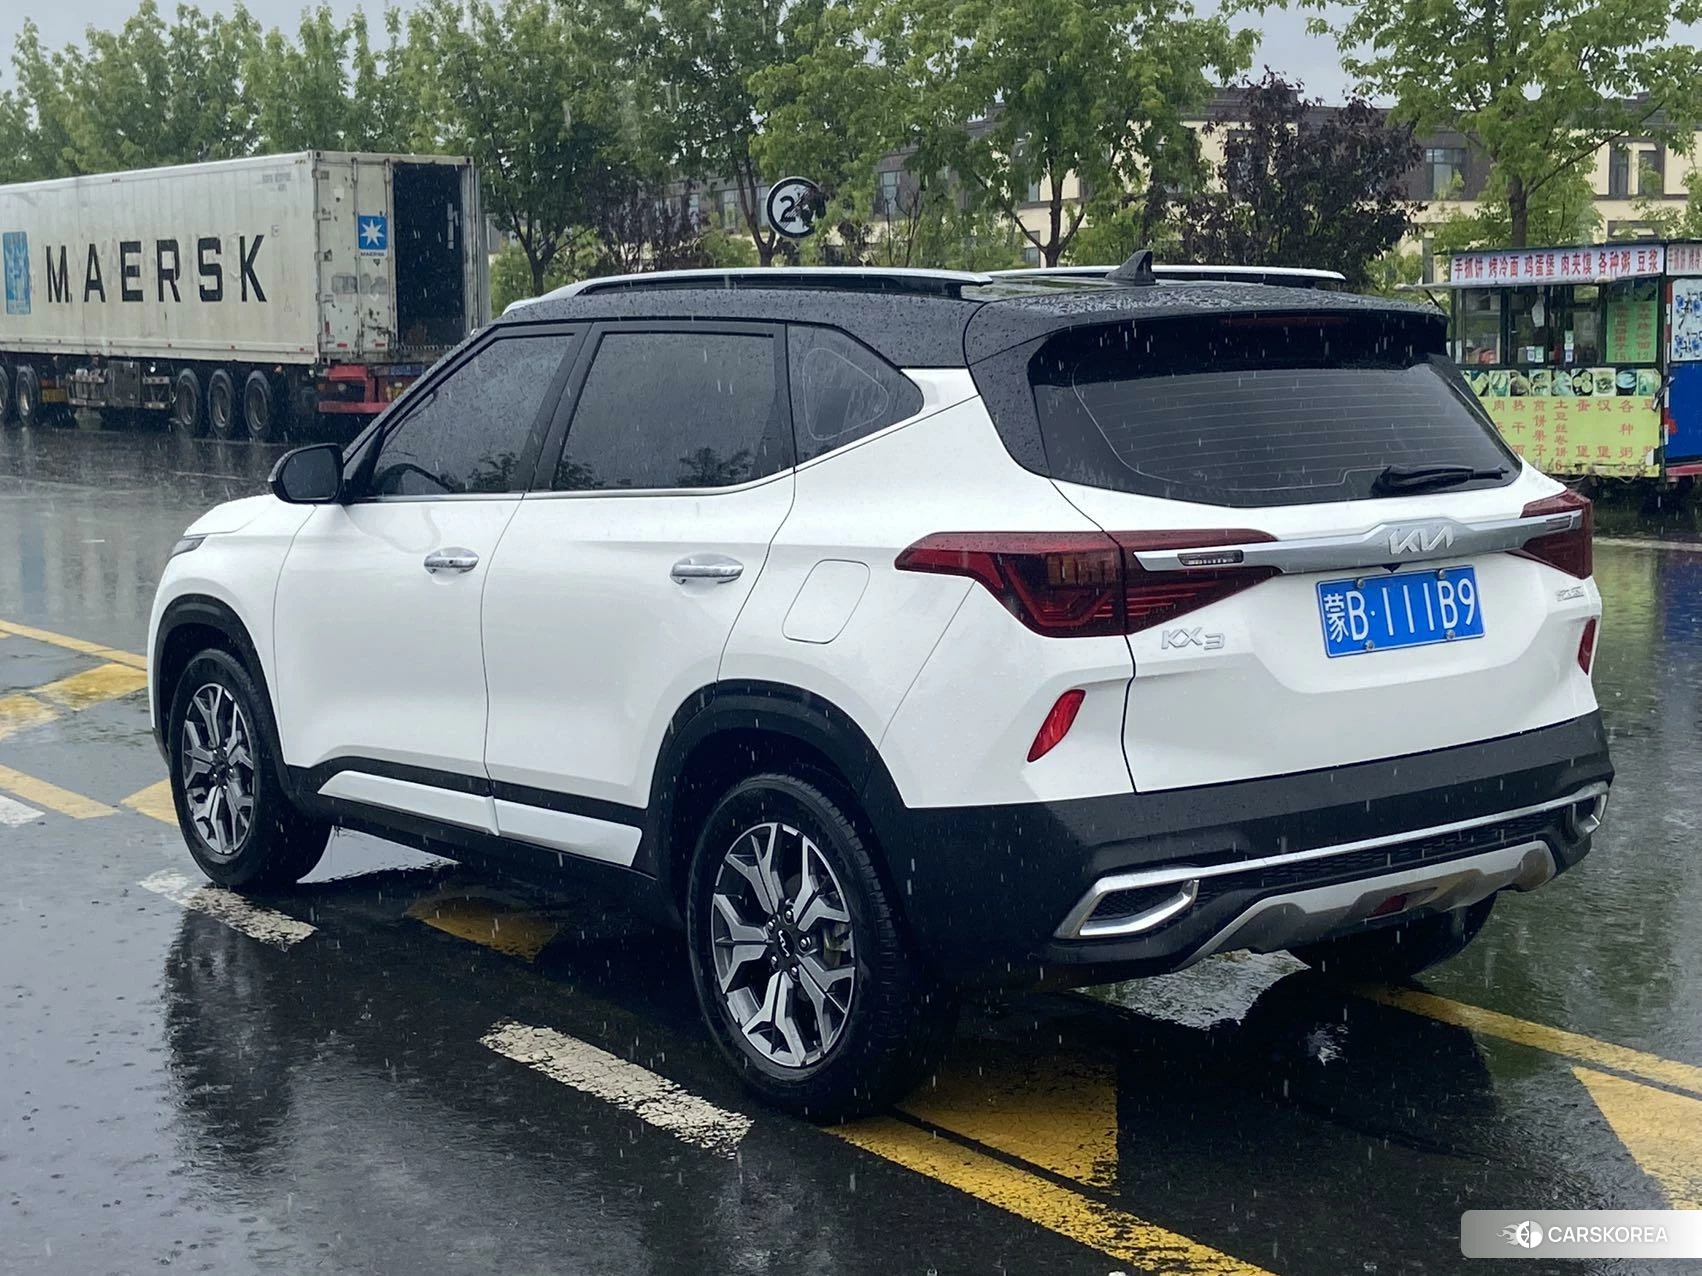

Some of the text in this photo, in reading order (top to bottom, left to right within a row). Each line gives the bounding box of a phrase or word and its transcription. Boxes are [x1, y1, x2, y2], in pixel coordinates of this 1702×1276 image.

[46, 234, 267, 303] MAERSK
[1454, 257, 1483, 279] 手抓饼
[1488, 255, 1519, 278] 烤冷面
[1598, 249, 1631, 276] 各种粥
[1636, 248, 1658, 273] 豆浆
[1388, 525, 1455, 555] KIA
[1161, 626, 1225, 651] KX3
